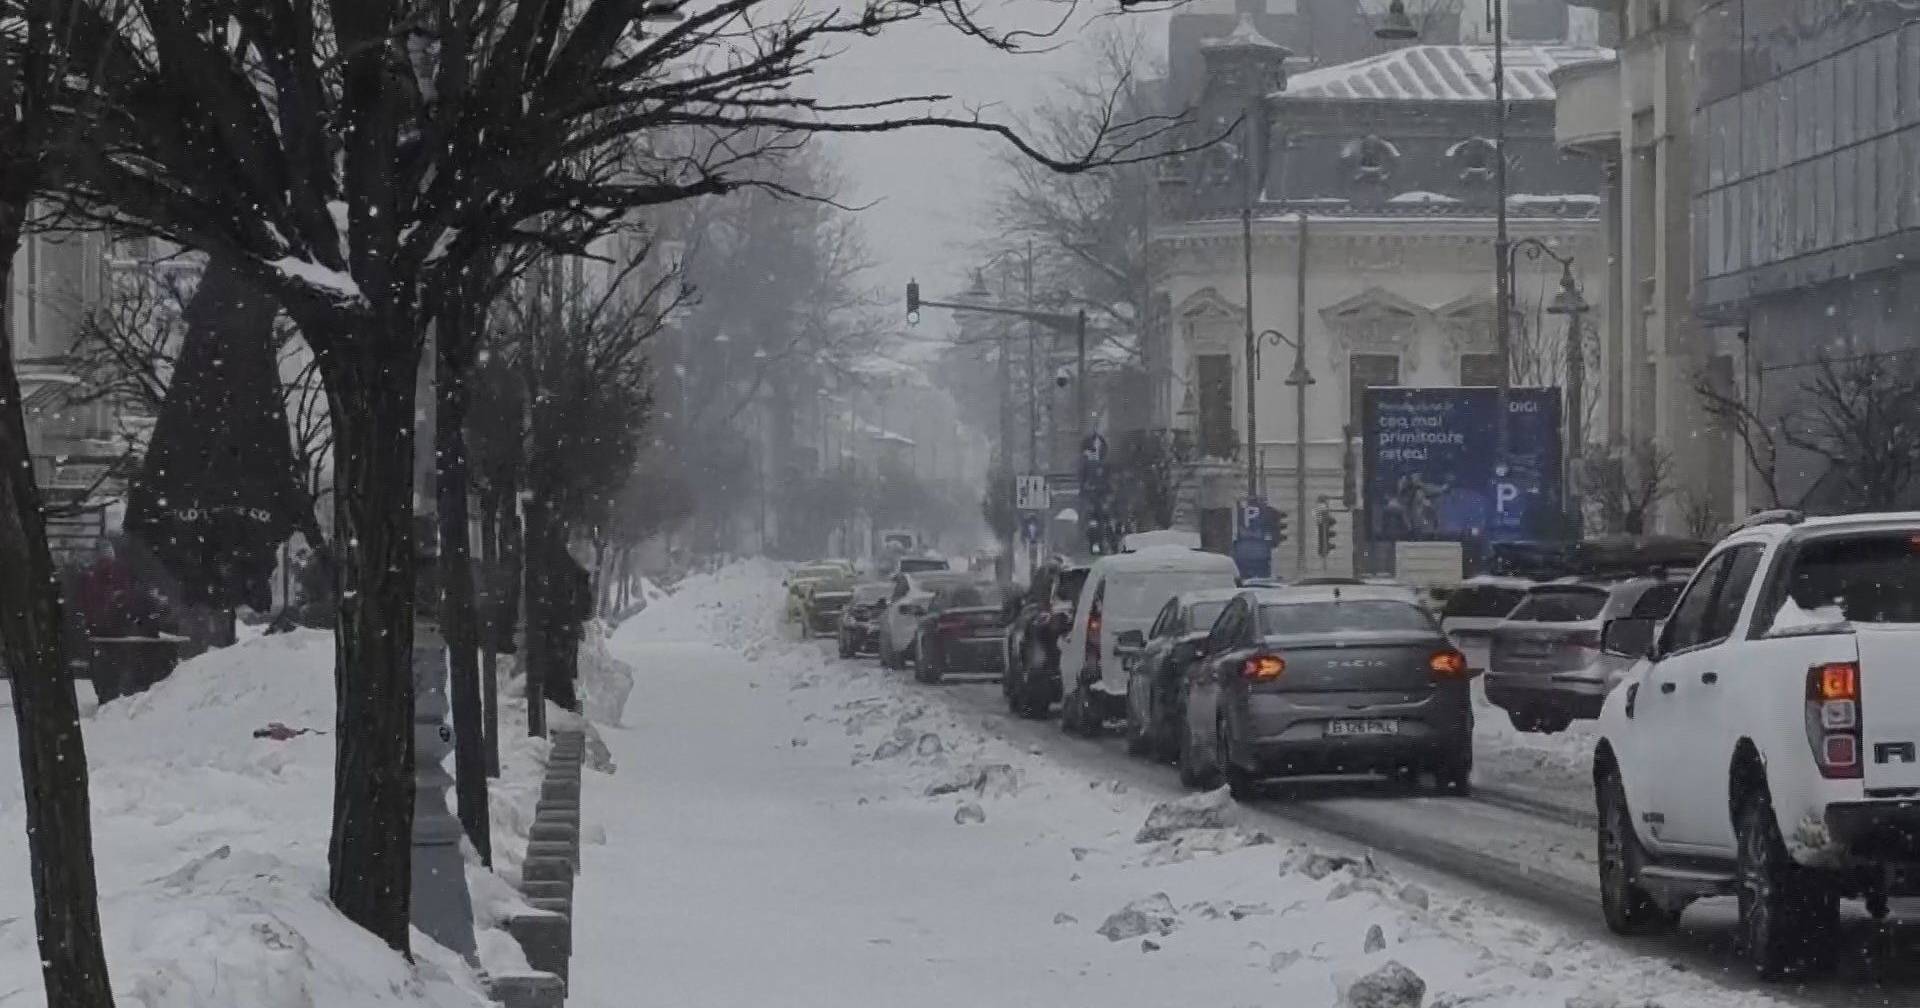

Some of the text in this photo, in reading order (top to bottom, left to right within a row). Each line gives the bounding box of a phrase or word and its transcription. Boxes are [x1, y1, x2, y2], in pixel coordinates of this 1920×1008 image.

[1509, 401, 1537, 412] DIGI
[1496, 483, 1518, 512] P
[1244, 506, 1260, 527] P
